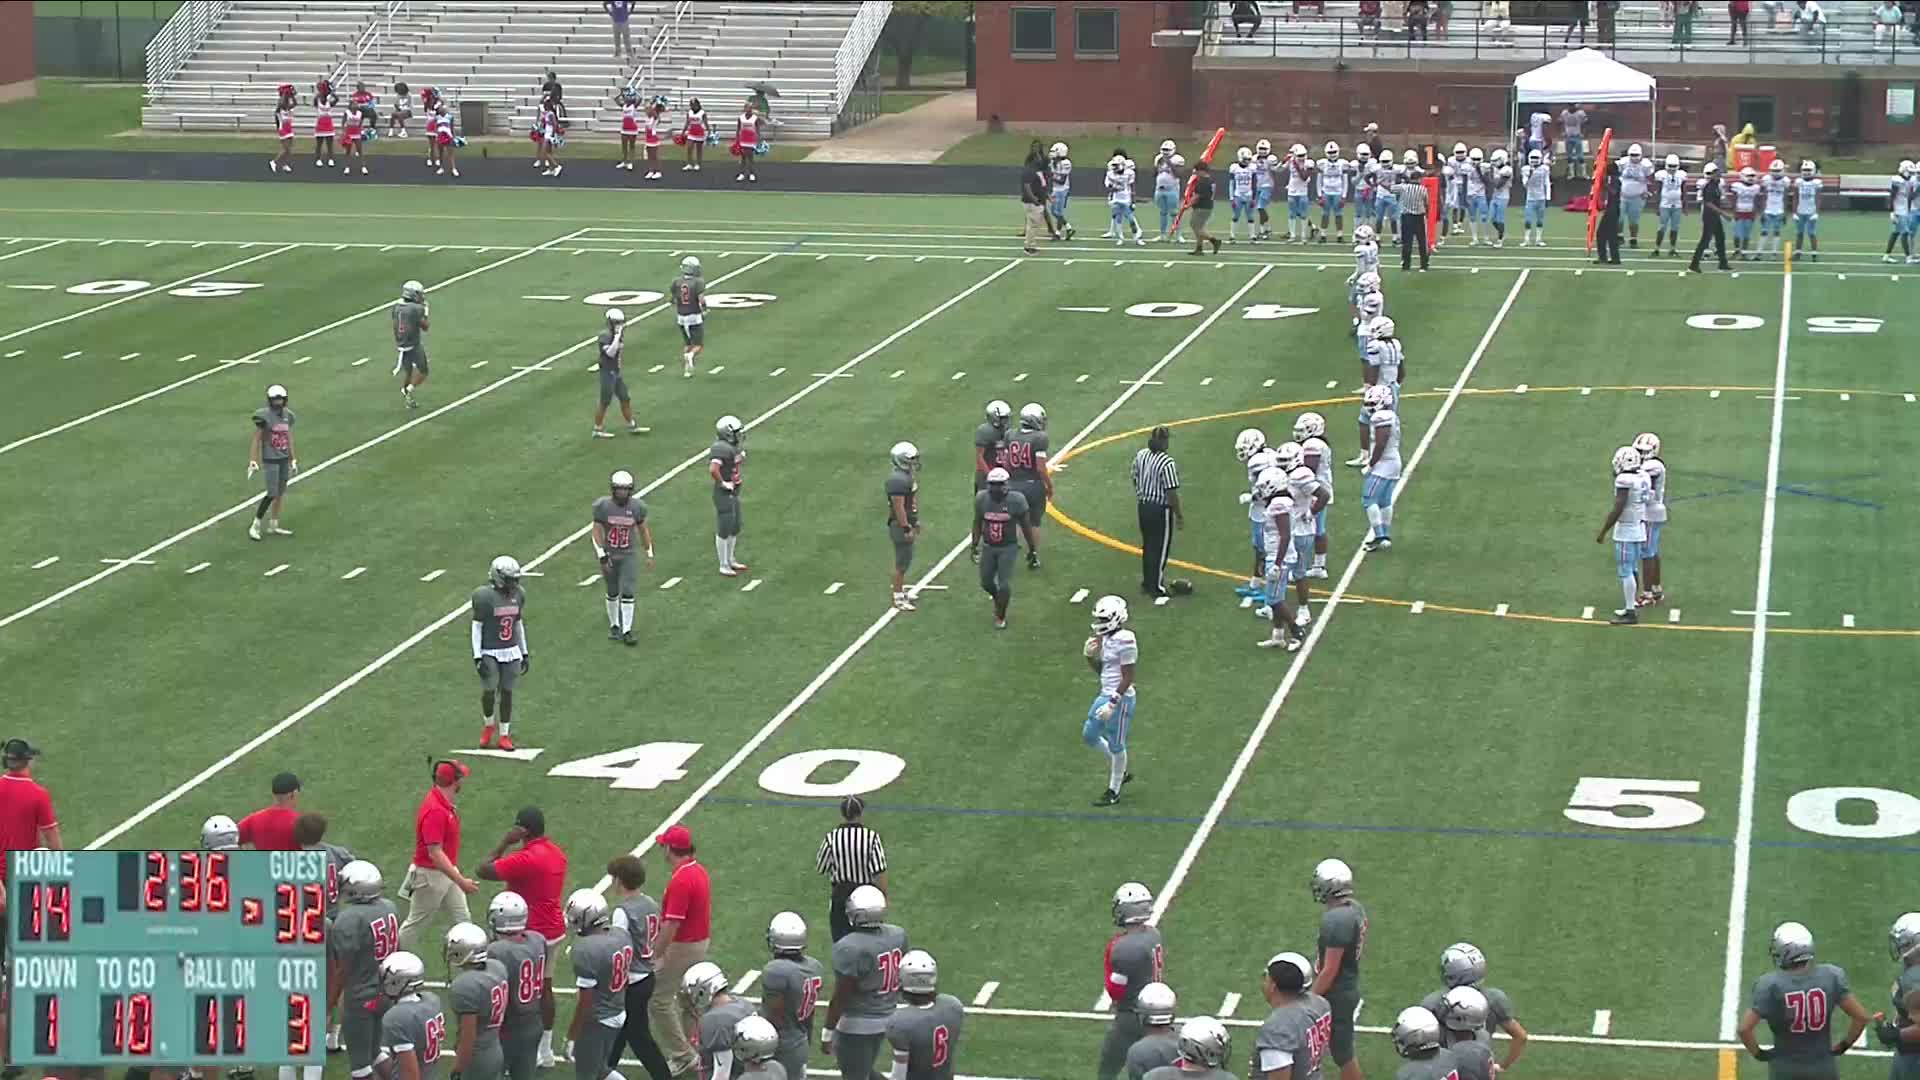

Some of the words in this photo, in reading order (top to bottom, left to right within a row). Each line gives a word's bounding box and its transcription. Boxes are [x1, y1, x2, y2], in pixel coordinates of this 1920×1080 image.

[681, 283, 691, 305] 2
[498, 616, 513, 641] 3
[1785, 987, 1827, 1033] 70
[933, 1023, 950, 1068] 6
